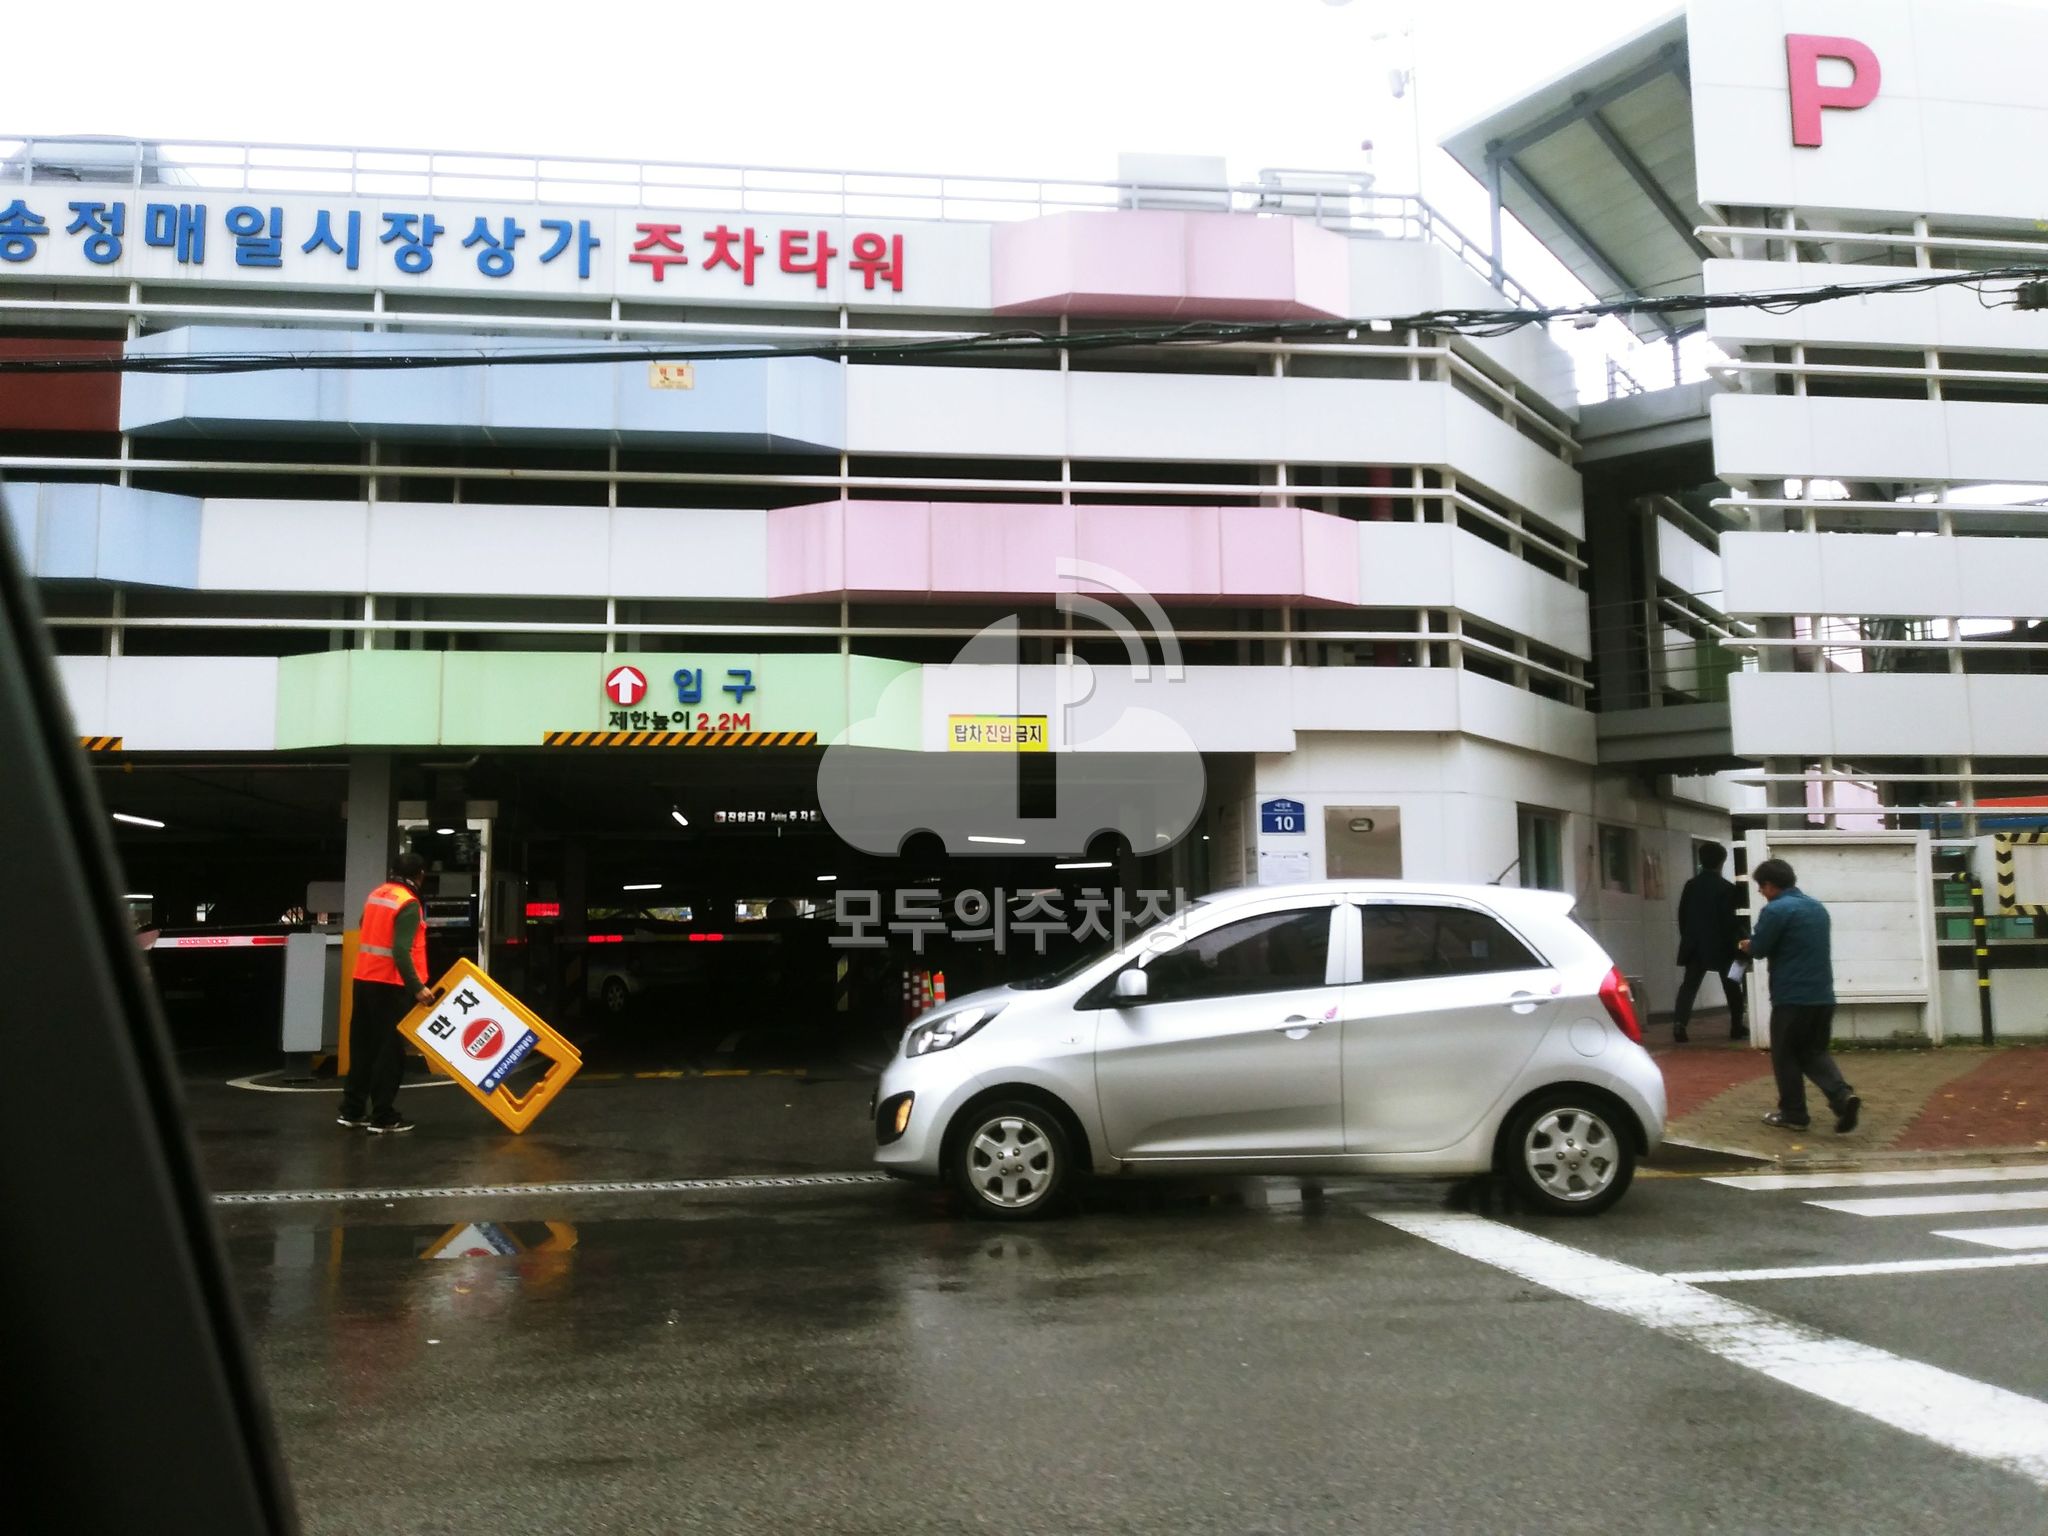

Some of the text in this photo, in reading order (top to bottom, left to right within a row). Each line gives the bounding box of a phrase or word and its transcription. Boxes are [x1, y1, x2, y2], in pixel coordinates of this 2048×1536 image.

[1785, 33, 1881, 148] P
[0, 199, 904, 292] 송정매일시장상가 주차타워
[608, 710, 690, 731] 제한높이
[954, 724, 1042, 744] 탑차 진입 금지
[1275, 816, 1294, 831] 10
